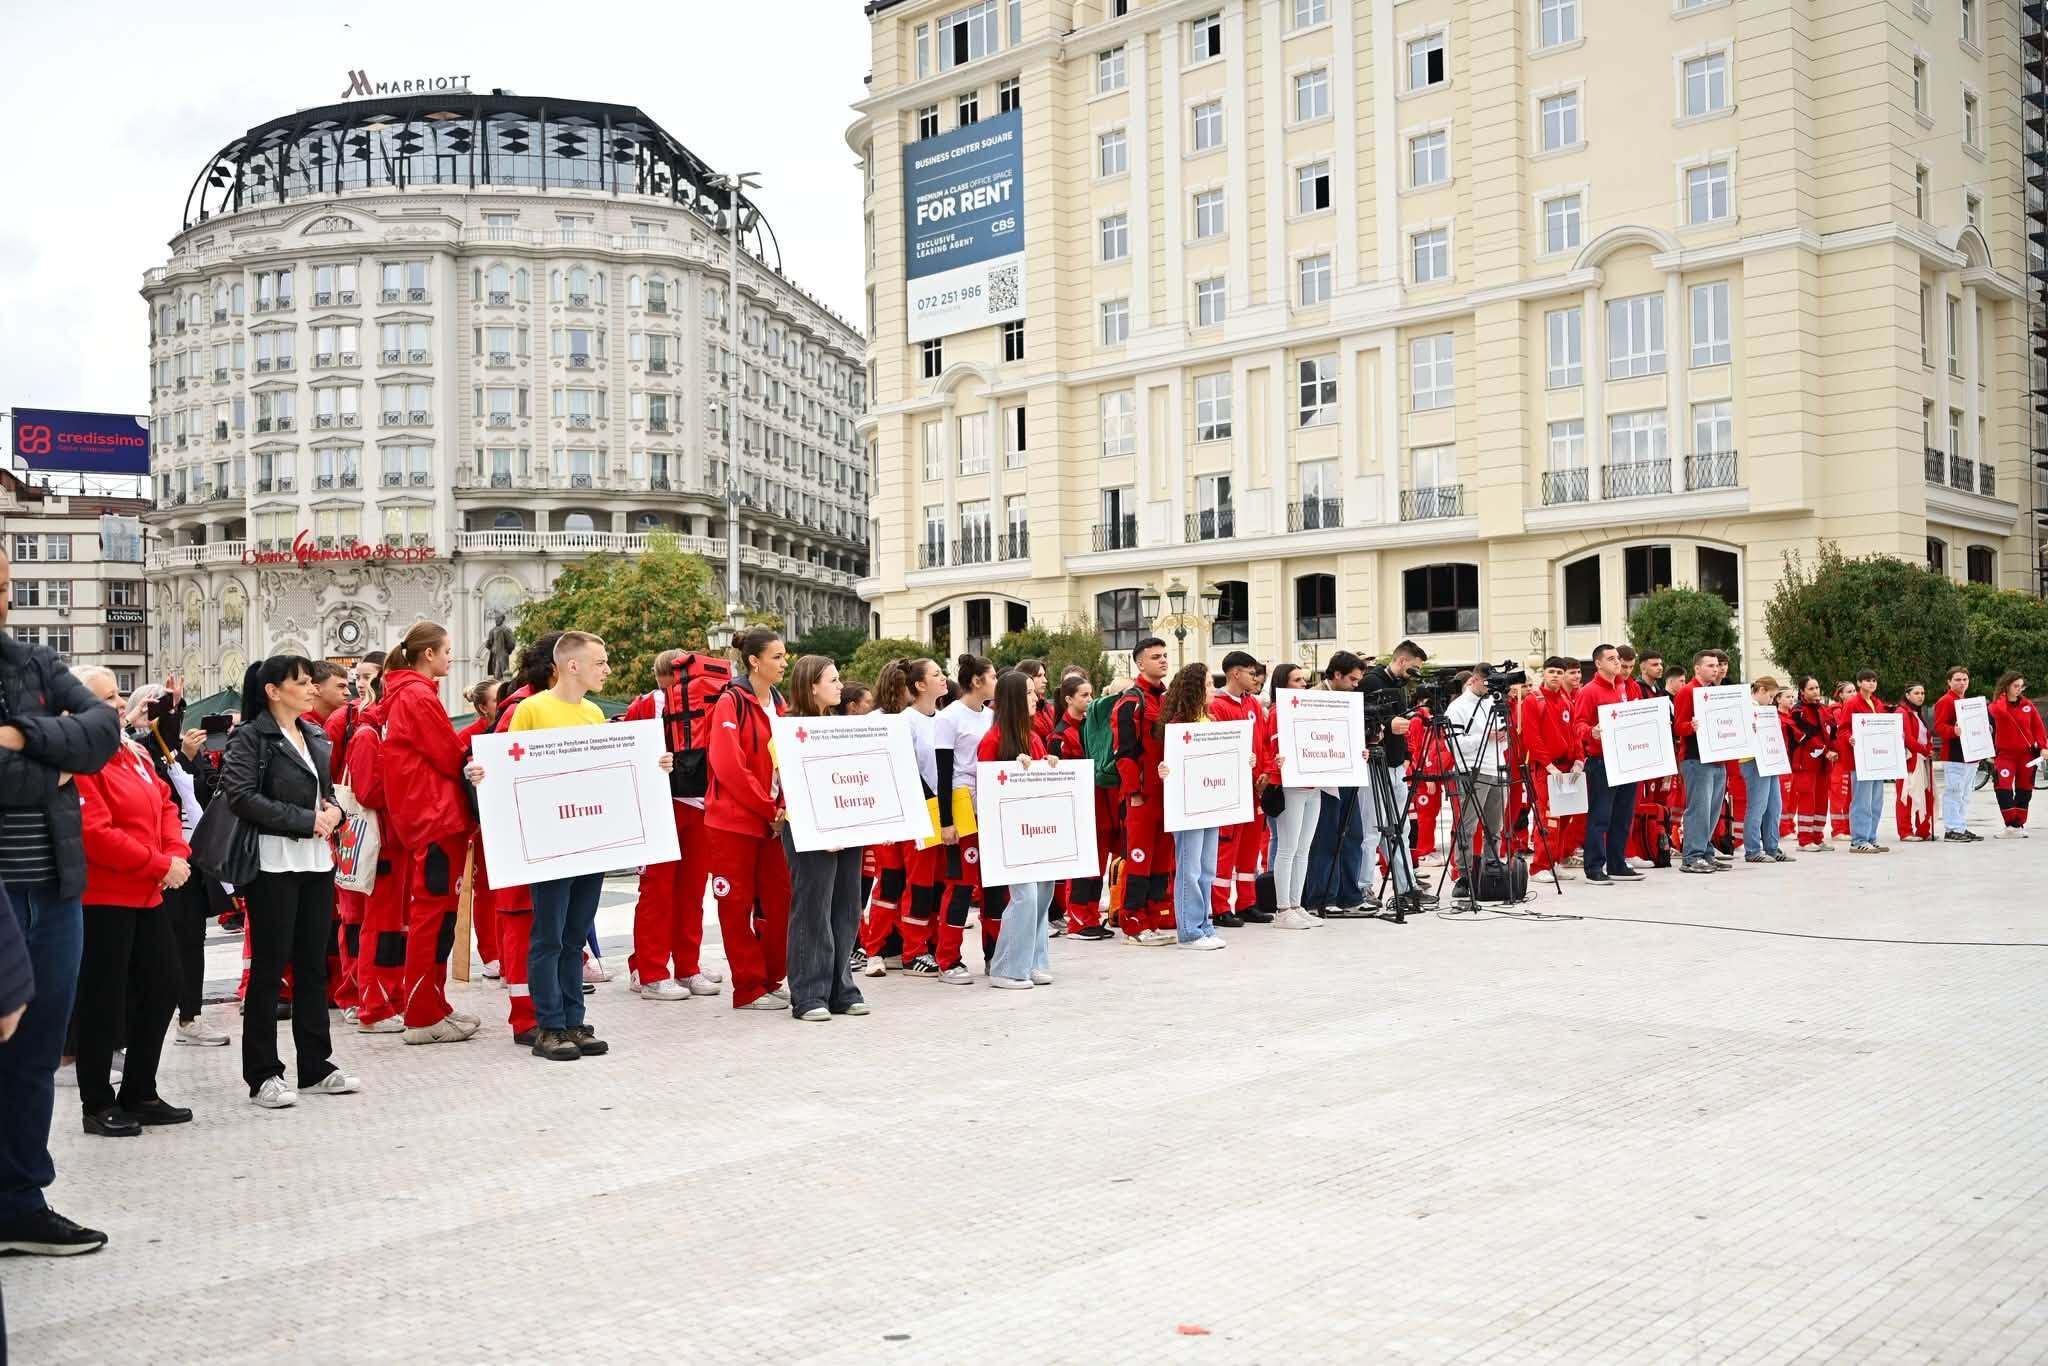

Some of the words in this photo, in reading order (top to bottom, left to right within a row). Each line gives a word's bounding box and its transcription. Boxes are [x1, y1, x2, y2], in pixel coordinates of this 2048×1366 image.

[376, 75, 471, 94] MARRIOTT
[915, 152, 950, 169] BUSINESS
[951, 142, 980, 158] CENTER
[981, 131, 1013, 148] SQUARE
[917, 190, 943, 203] PREMIUM
[950, 183, 969, 194] CLASS
[969, 176, 992, 188] OFFICE
[992, 169, 1013, 180] SPACE
[917, 197, 956, 225] FOR
[960, 179, 1013, 213] RENT
[991, 217, 1015, 232] CBS
[916, 234, 955, 250] EXCLUSIVE
[917, 245, 947, 258] LEASING
[949, 237, 974, 250] AGENT
[917, 296, 937, 310] 072
[941, 291, 958, 305] 251
[961, 285, 981, 300] 986
[57, 432, 145, 447] credissimo
[831, 770, 869, 785] Скопје
[1202, 777, 1226, 789] Охрид
[833, 795, 875, 809] Центар
[558, 803, 604, 820] Штип
[1021, 823, 1057, 838] Прилеп
